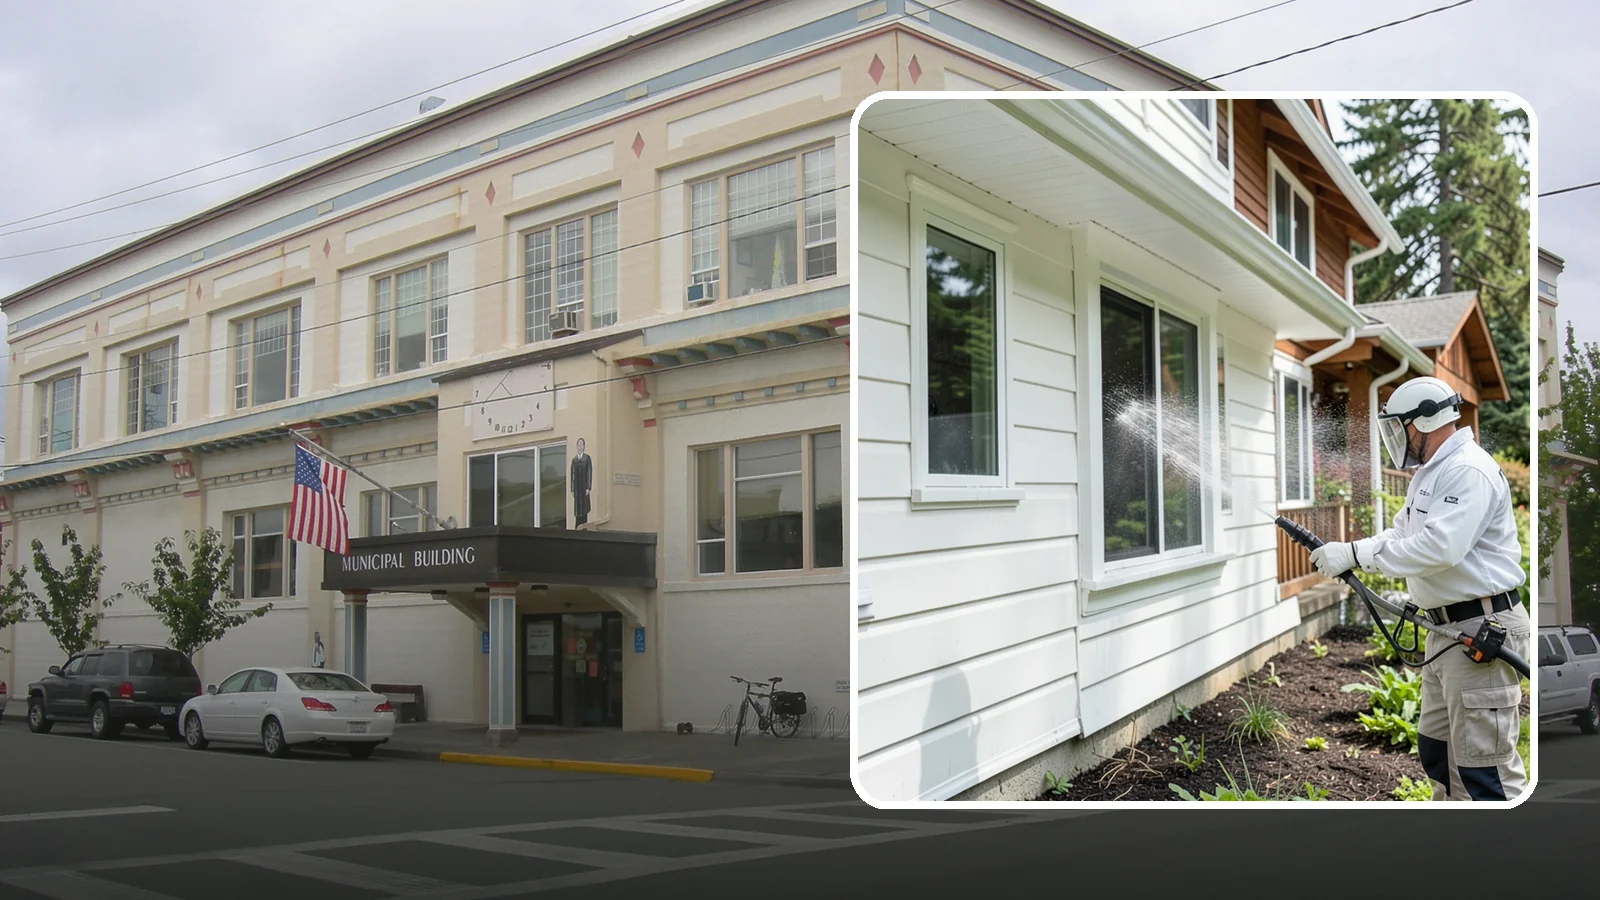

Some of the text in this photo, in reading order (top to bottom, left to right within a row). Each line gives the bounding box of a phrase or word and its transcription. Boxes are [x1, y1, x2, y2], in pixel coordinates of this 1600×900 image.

[494, 423, 500, 431] 10
[501, 425, 506, 433] 11
[507, 425, 513, 433] 12
[342, 546, 475, 572] MUNICIPAL BUILDING
